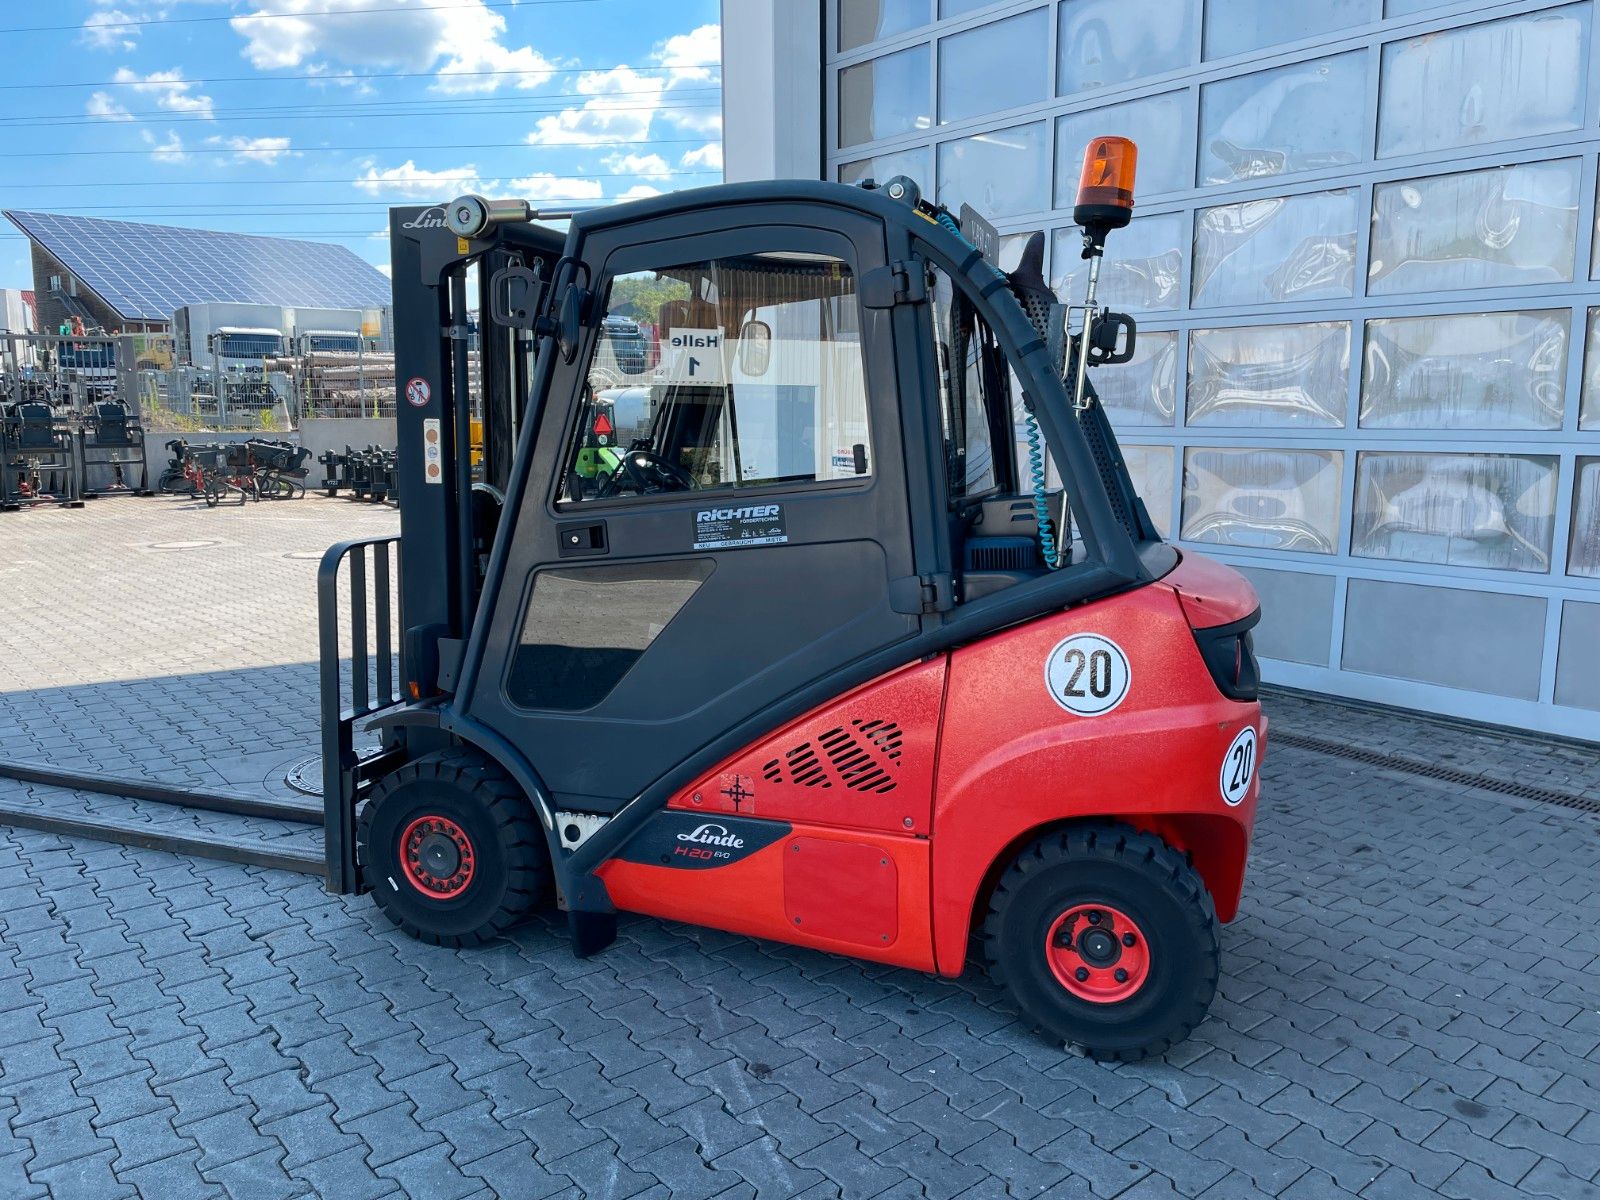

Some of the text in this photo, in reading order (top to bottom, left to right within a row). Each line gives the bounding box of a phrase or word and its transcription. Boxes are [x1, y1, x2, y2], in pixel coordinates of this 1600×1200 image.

[402, 206, 448, 229] Lin
[1063, 648, 1112, 699] 20
[1229, 738, 1253, 793] 20
[677, 823, 744, 849] Linde
[713, 851, 731, 859] EVO
